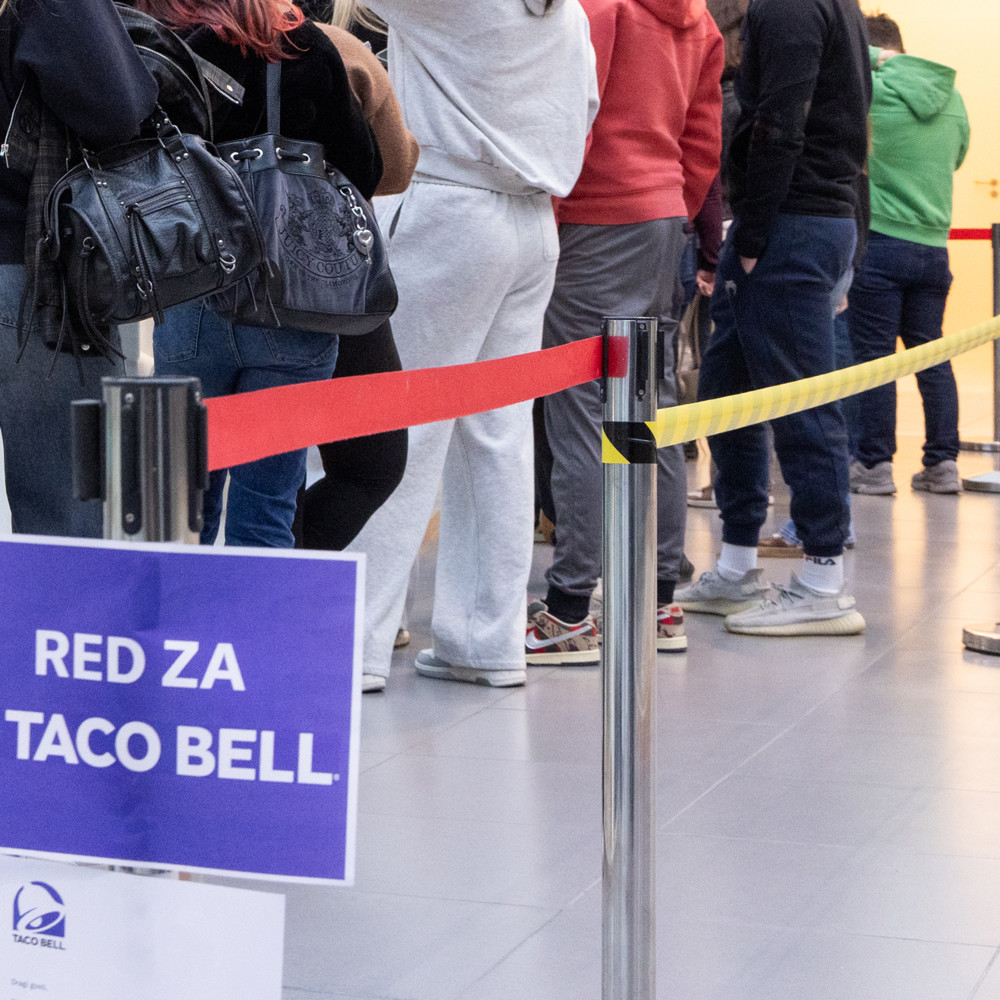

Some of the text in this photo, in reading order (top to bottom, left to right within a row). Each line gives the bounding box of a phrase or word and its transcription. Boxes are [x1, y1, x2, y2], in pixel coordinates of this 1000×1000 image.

[35, 629, 246, 691] RED ZA
[5, 709, 333, 786] TACO BELL
[12, 934, 66, 951] TACO BELL
